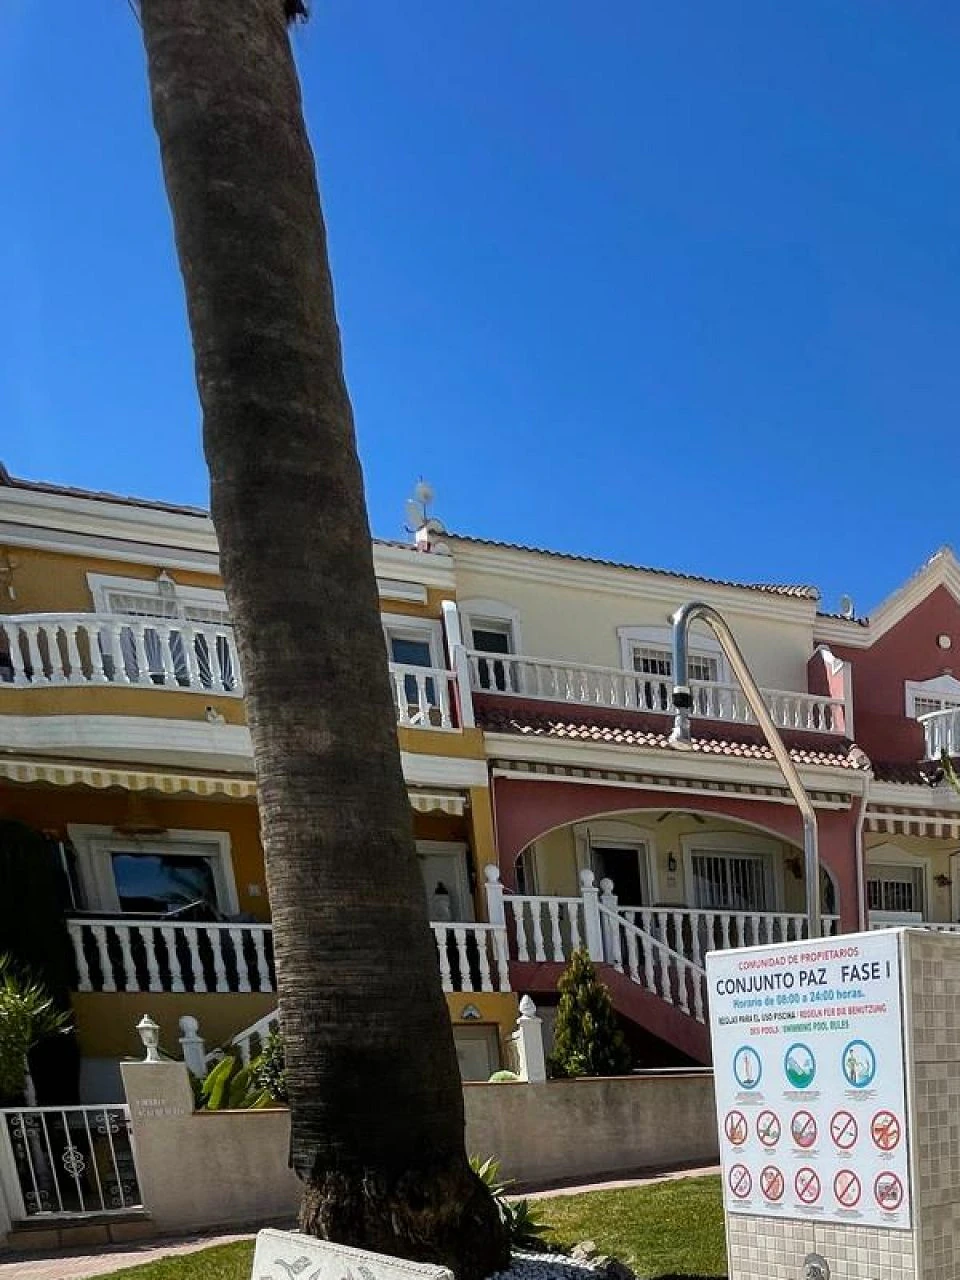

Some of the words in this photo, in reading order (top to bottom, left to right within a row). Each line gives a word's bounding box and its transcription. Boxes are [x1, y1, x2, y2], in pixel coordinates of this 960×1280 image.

[738, 956, 786, 970] COMUNIDAD
[788, 954, 799, 964] DE
[800, 946, 859, 963] PROPIETARIOS
[716, 972, 794, 995] CONJUNTO
[799, 968, 828, 987] PAZ
[841, 961, 881, 983] FASE
[886, 960, 891, 979] I
[733, 998, 763, 1009] Horario
[764, 995, 774, 1006] de
[776, 993, 800, 1005] 08:00
[802, 995, 808, 1003] a
[809, 990, 834, 1003] 24:00
